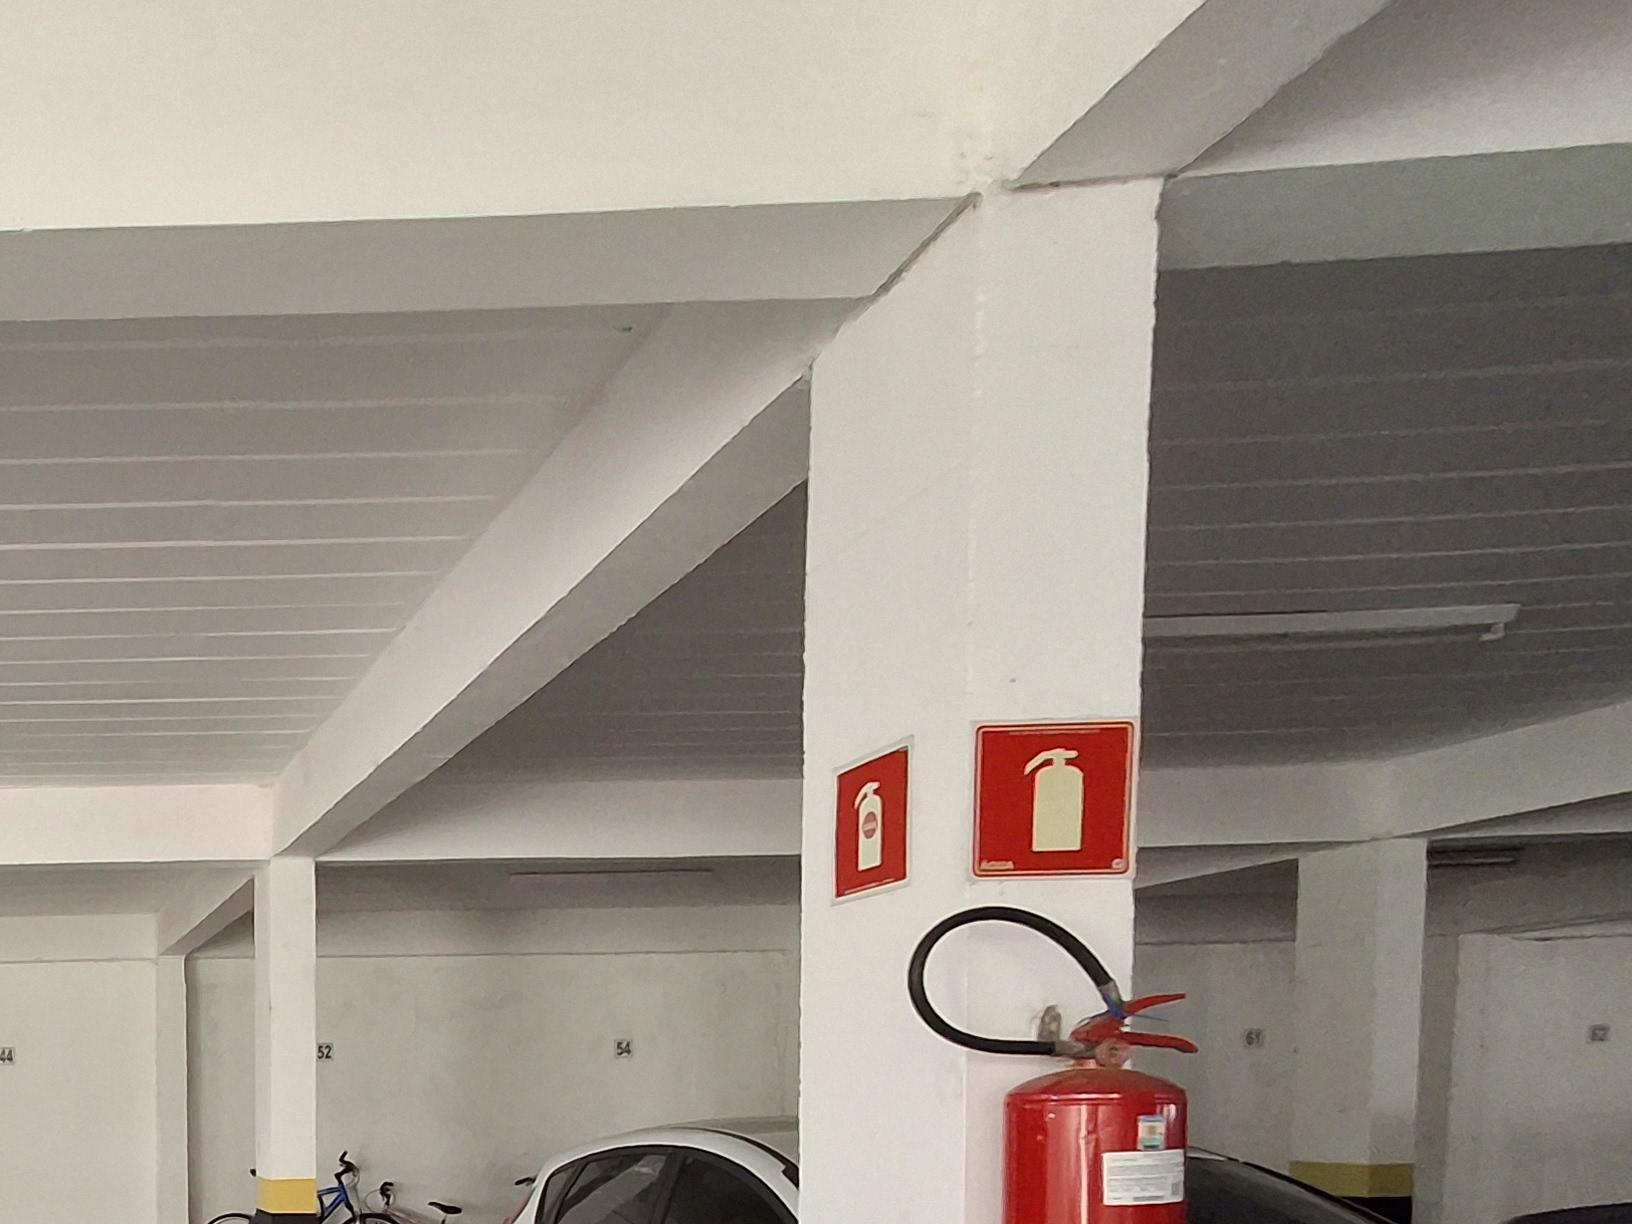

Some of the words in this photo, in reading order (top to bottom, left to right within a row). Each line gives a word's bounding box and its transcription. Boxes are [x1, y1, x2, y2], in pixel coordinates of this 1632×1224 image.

[0, 1047, 14, 1063] 44
[317, 1044, 332, 1060] 52
[616, 1039, 632, 1056] 54
